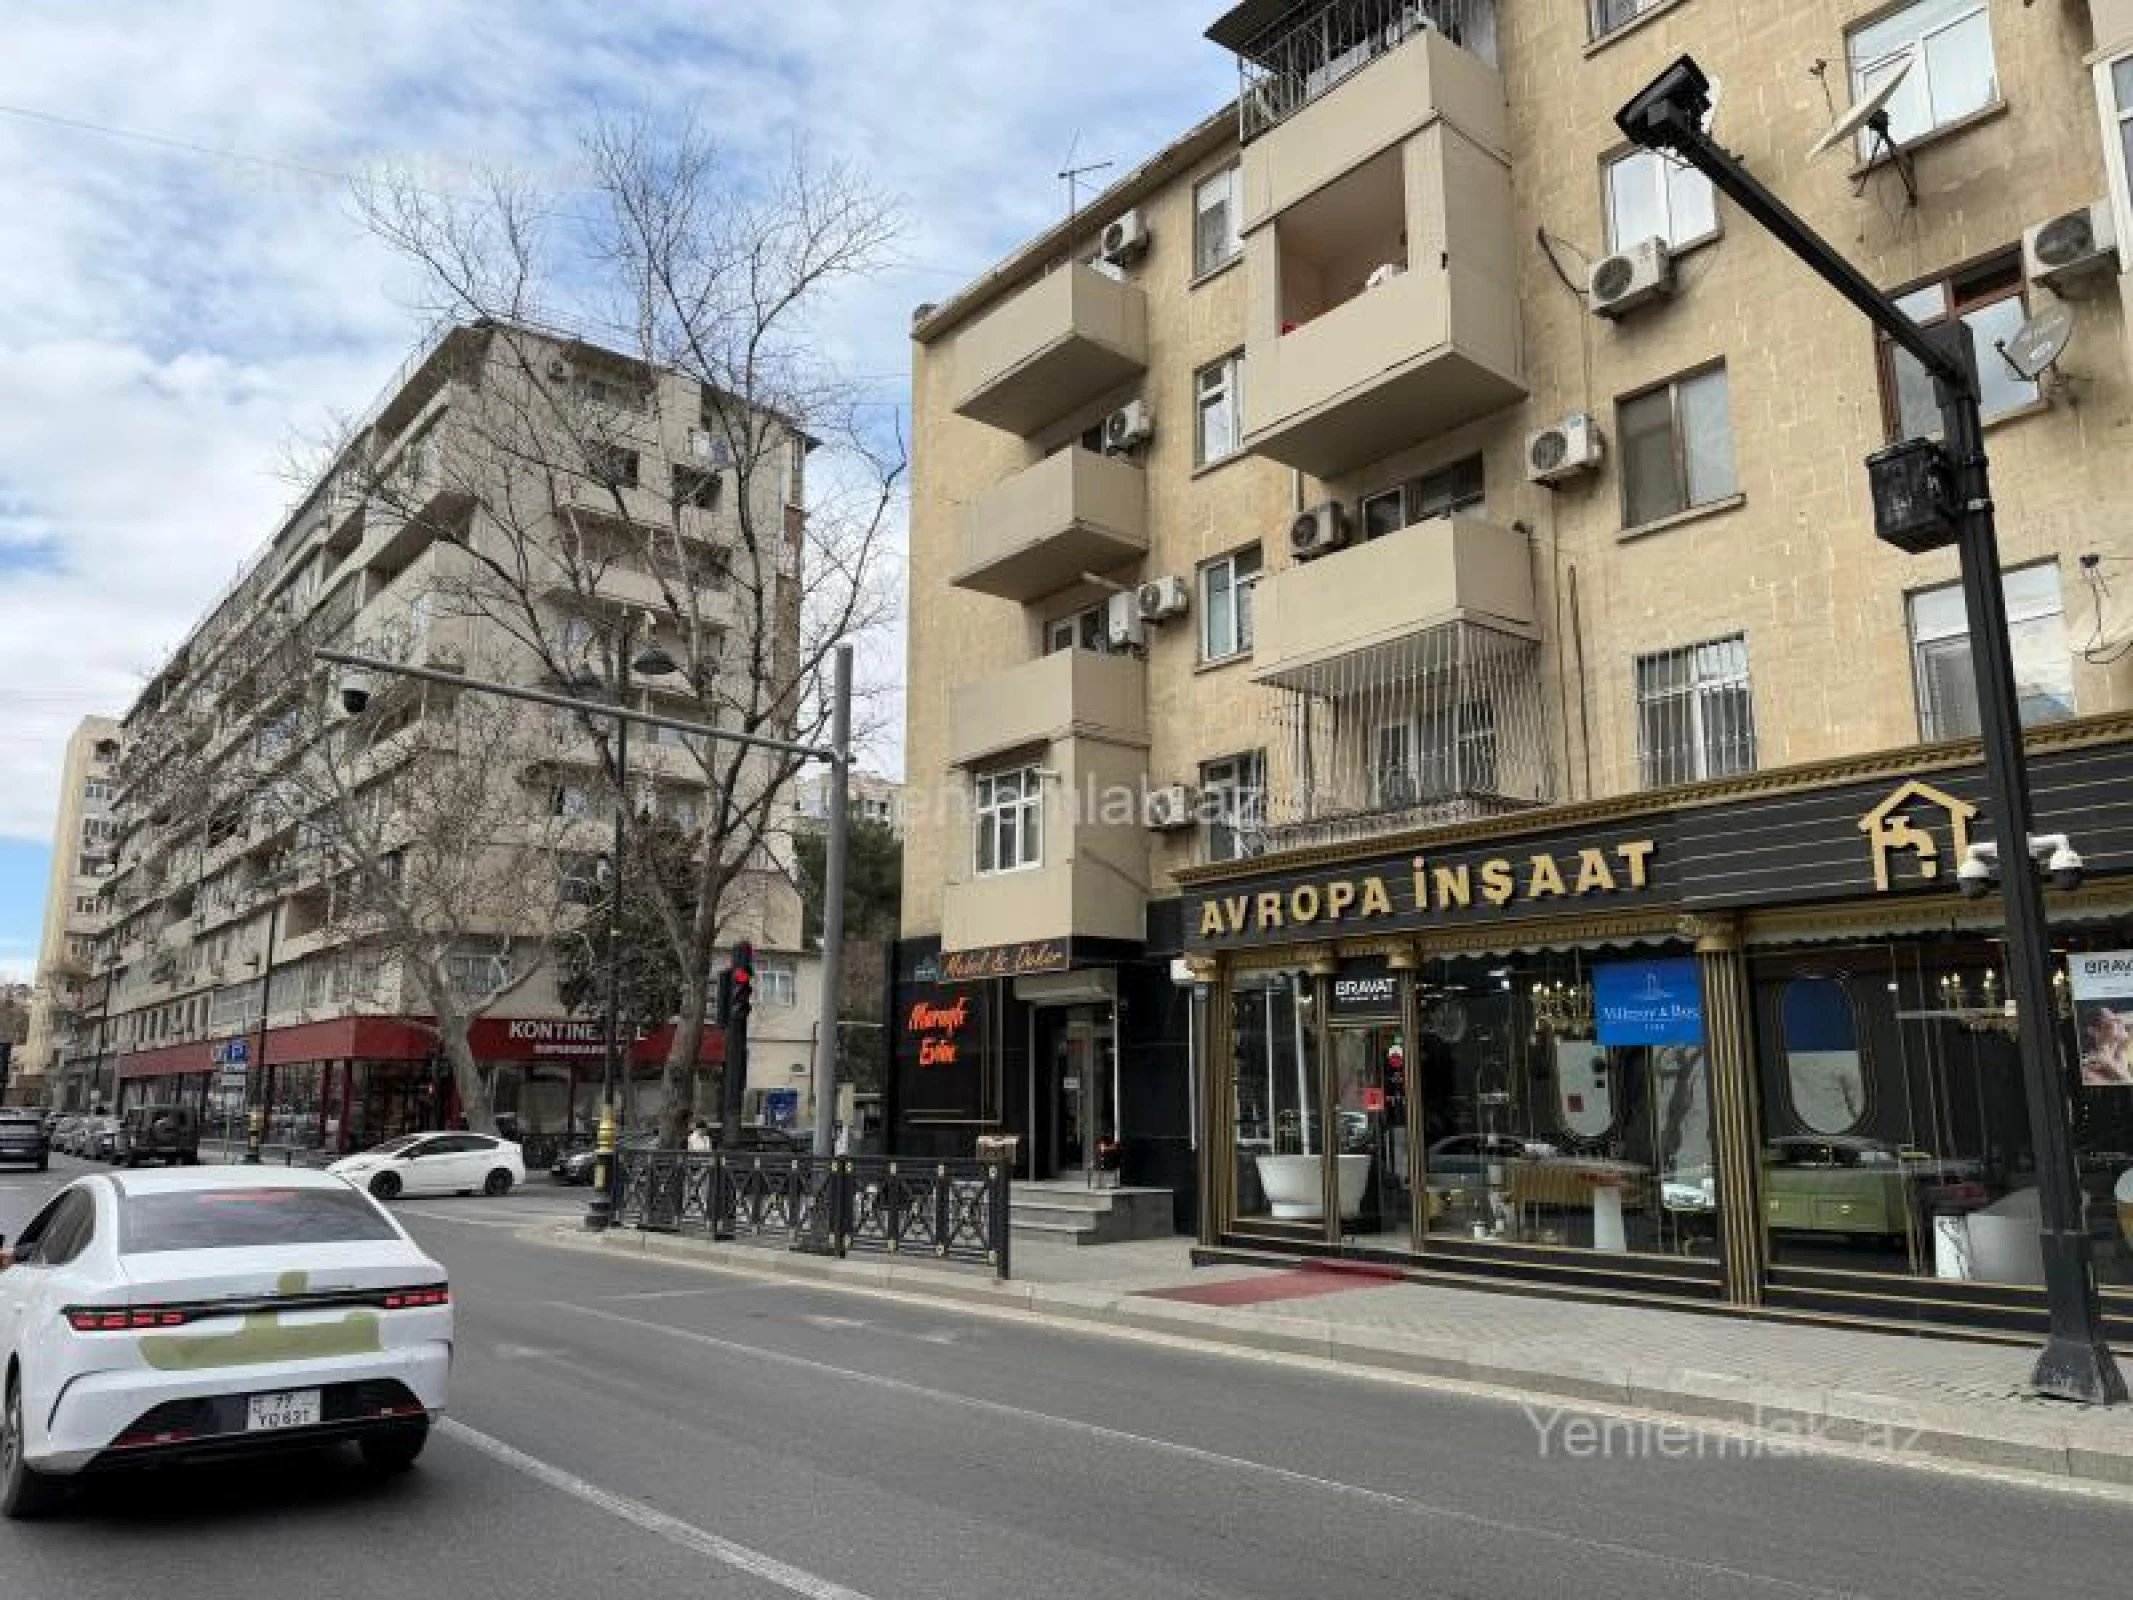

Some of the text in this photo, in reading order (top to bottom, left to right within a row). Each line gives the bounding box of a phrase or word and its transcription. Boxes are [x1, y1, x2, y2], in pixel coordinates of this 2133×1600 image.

[1199, 839, 1655, 938] AVROPA İNŞAAT
[509, 1020, 648, 1041] KONTINEL
